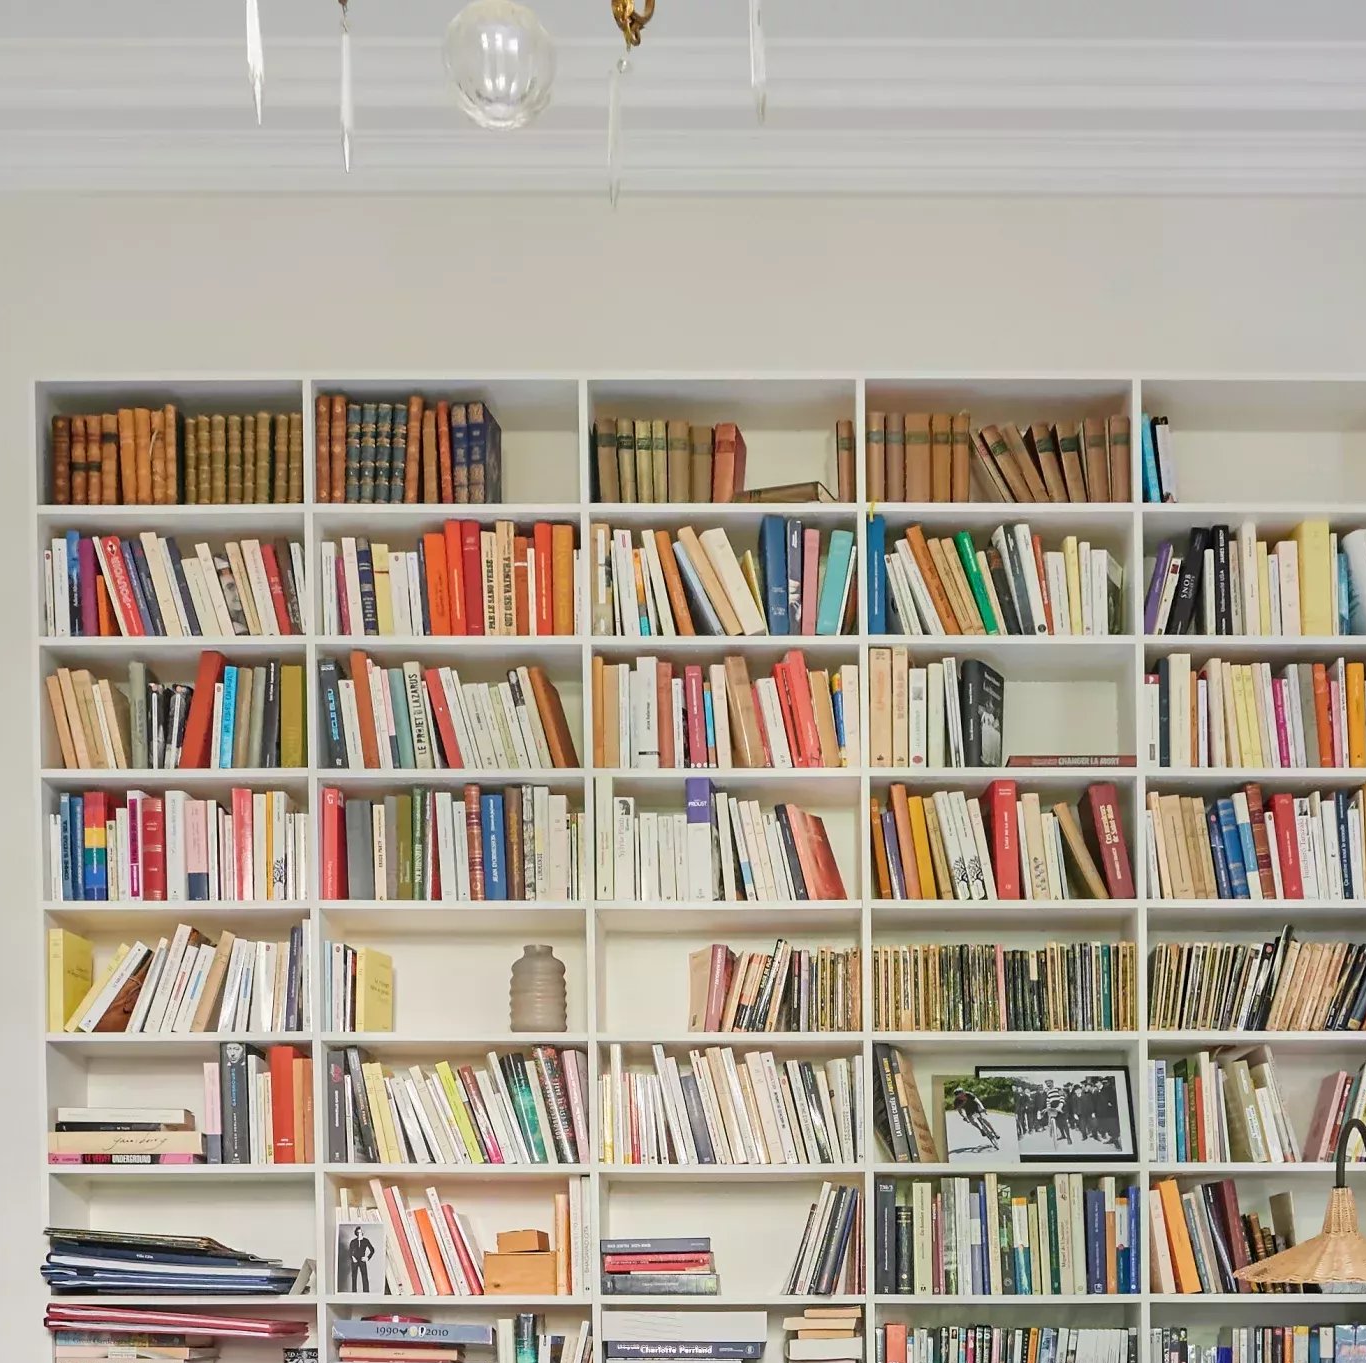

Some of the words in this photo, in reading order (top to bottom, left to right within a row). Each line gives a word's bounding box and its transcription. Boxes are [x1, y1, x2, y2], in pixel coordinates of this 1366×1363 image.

[1180, 573, 1191, 599] SNOB
[504, 595, 512, 610] OSE
[488, 605, 495, 614] LE
[408, 673, 421, 708] LAZARUS
[414, 717, 426, 744] PROJET
[418, 746, 426, 755] LE
[111, 1154, 151, 1164] UNDERGROUND
[375, 1327, 398, 1336] 1990
[424, 1328, 448, 1337] 2010
[639, 1345, 676, 1354] Charlotte
